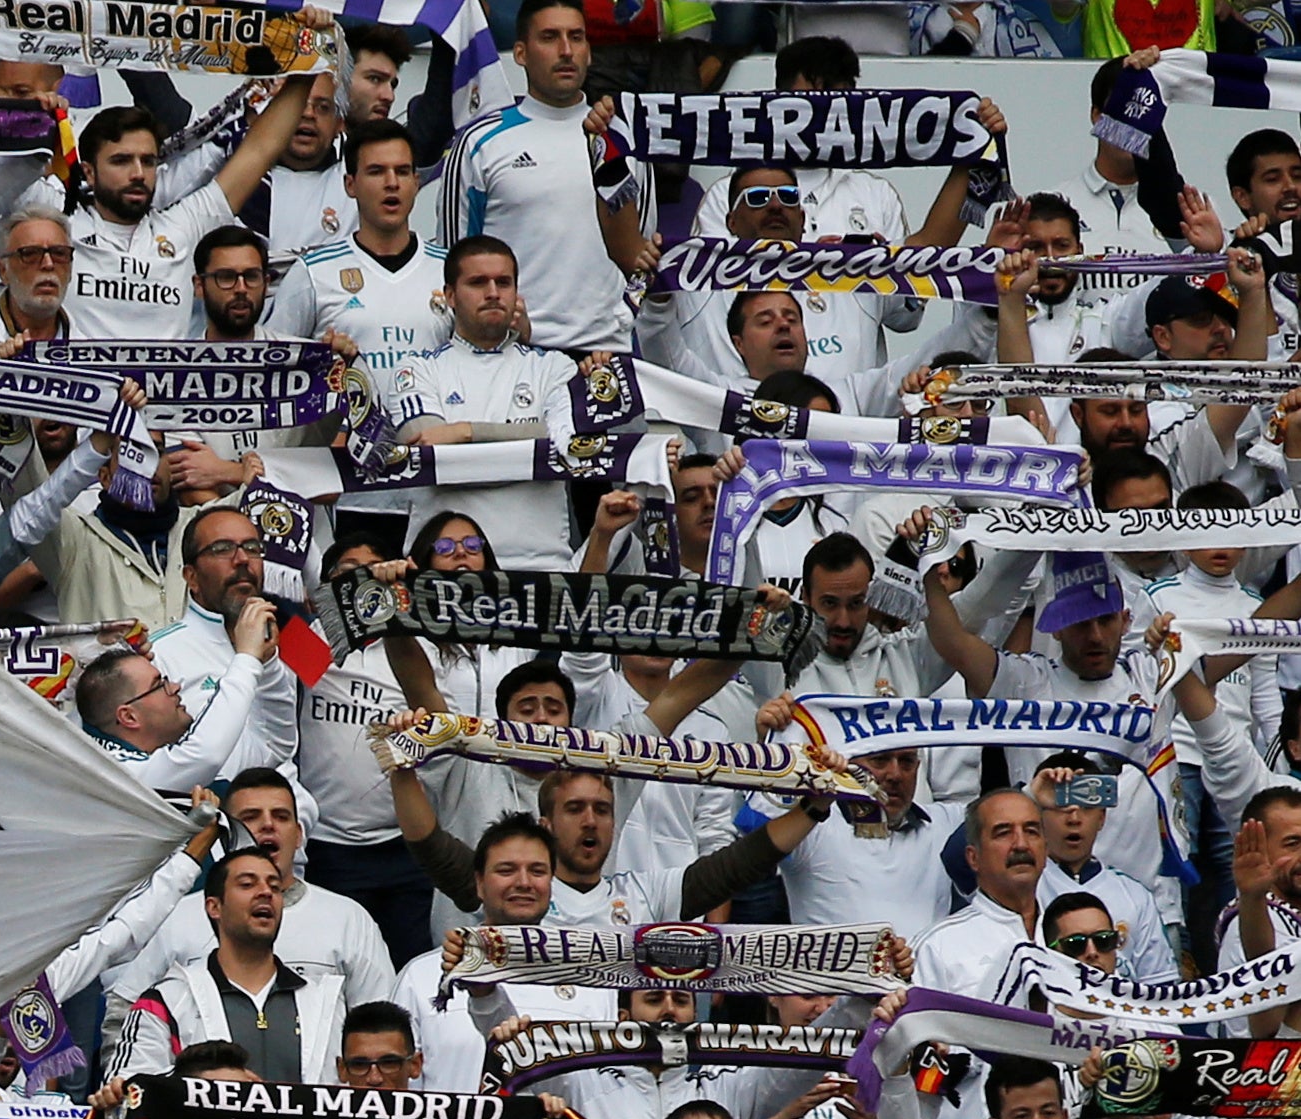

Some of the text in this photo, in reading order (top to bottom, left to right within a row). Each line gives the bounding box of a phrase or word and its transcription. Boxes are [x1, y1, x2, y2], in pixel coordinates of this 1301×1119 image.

[105, 3, 265, 45] Madrid
[46, 41, 82, 61] mejor
[142, 41, 162, 62] del
[119, 256, 150, 279] Fly
[657, 237, 1002, 292] Veteranos
[76, 275, 181, 306] Emirates
[44, 344, 291, 366] CENTENARIO
[145, 371, 312, 400] MADRID
[181, 406, 255, 425] 2002
[436, 583, 723, 640] Real Madrid
[839, 703, 954, 742] REAL
[524, 928, 859, 971] REAL MADRID
[1194, 1049, 1288, 1095] Real
[184, 1078, 303, 1114] REAL
